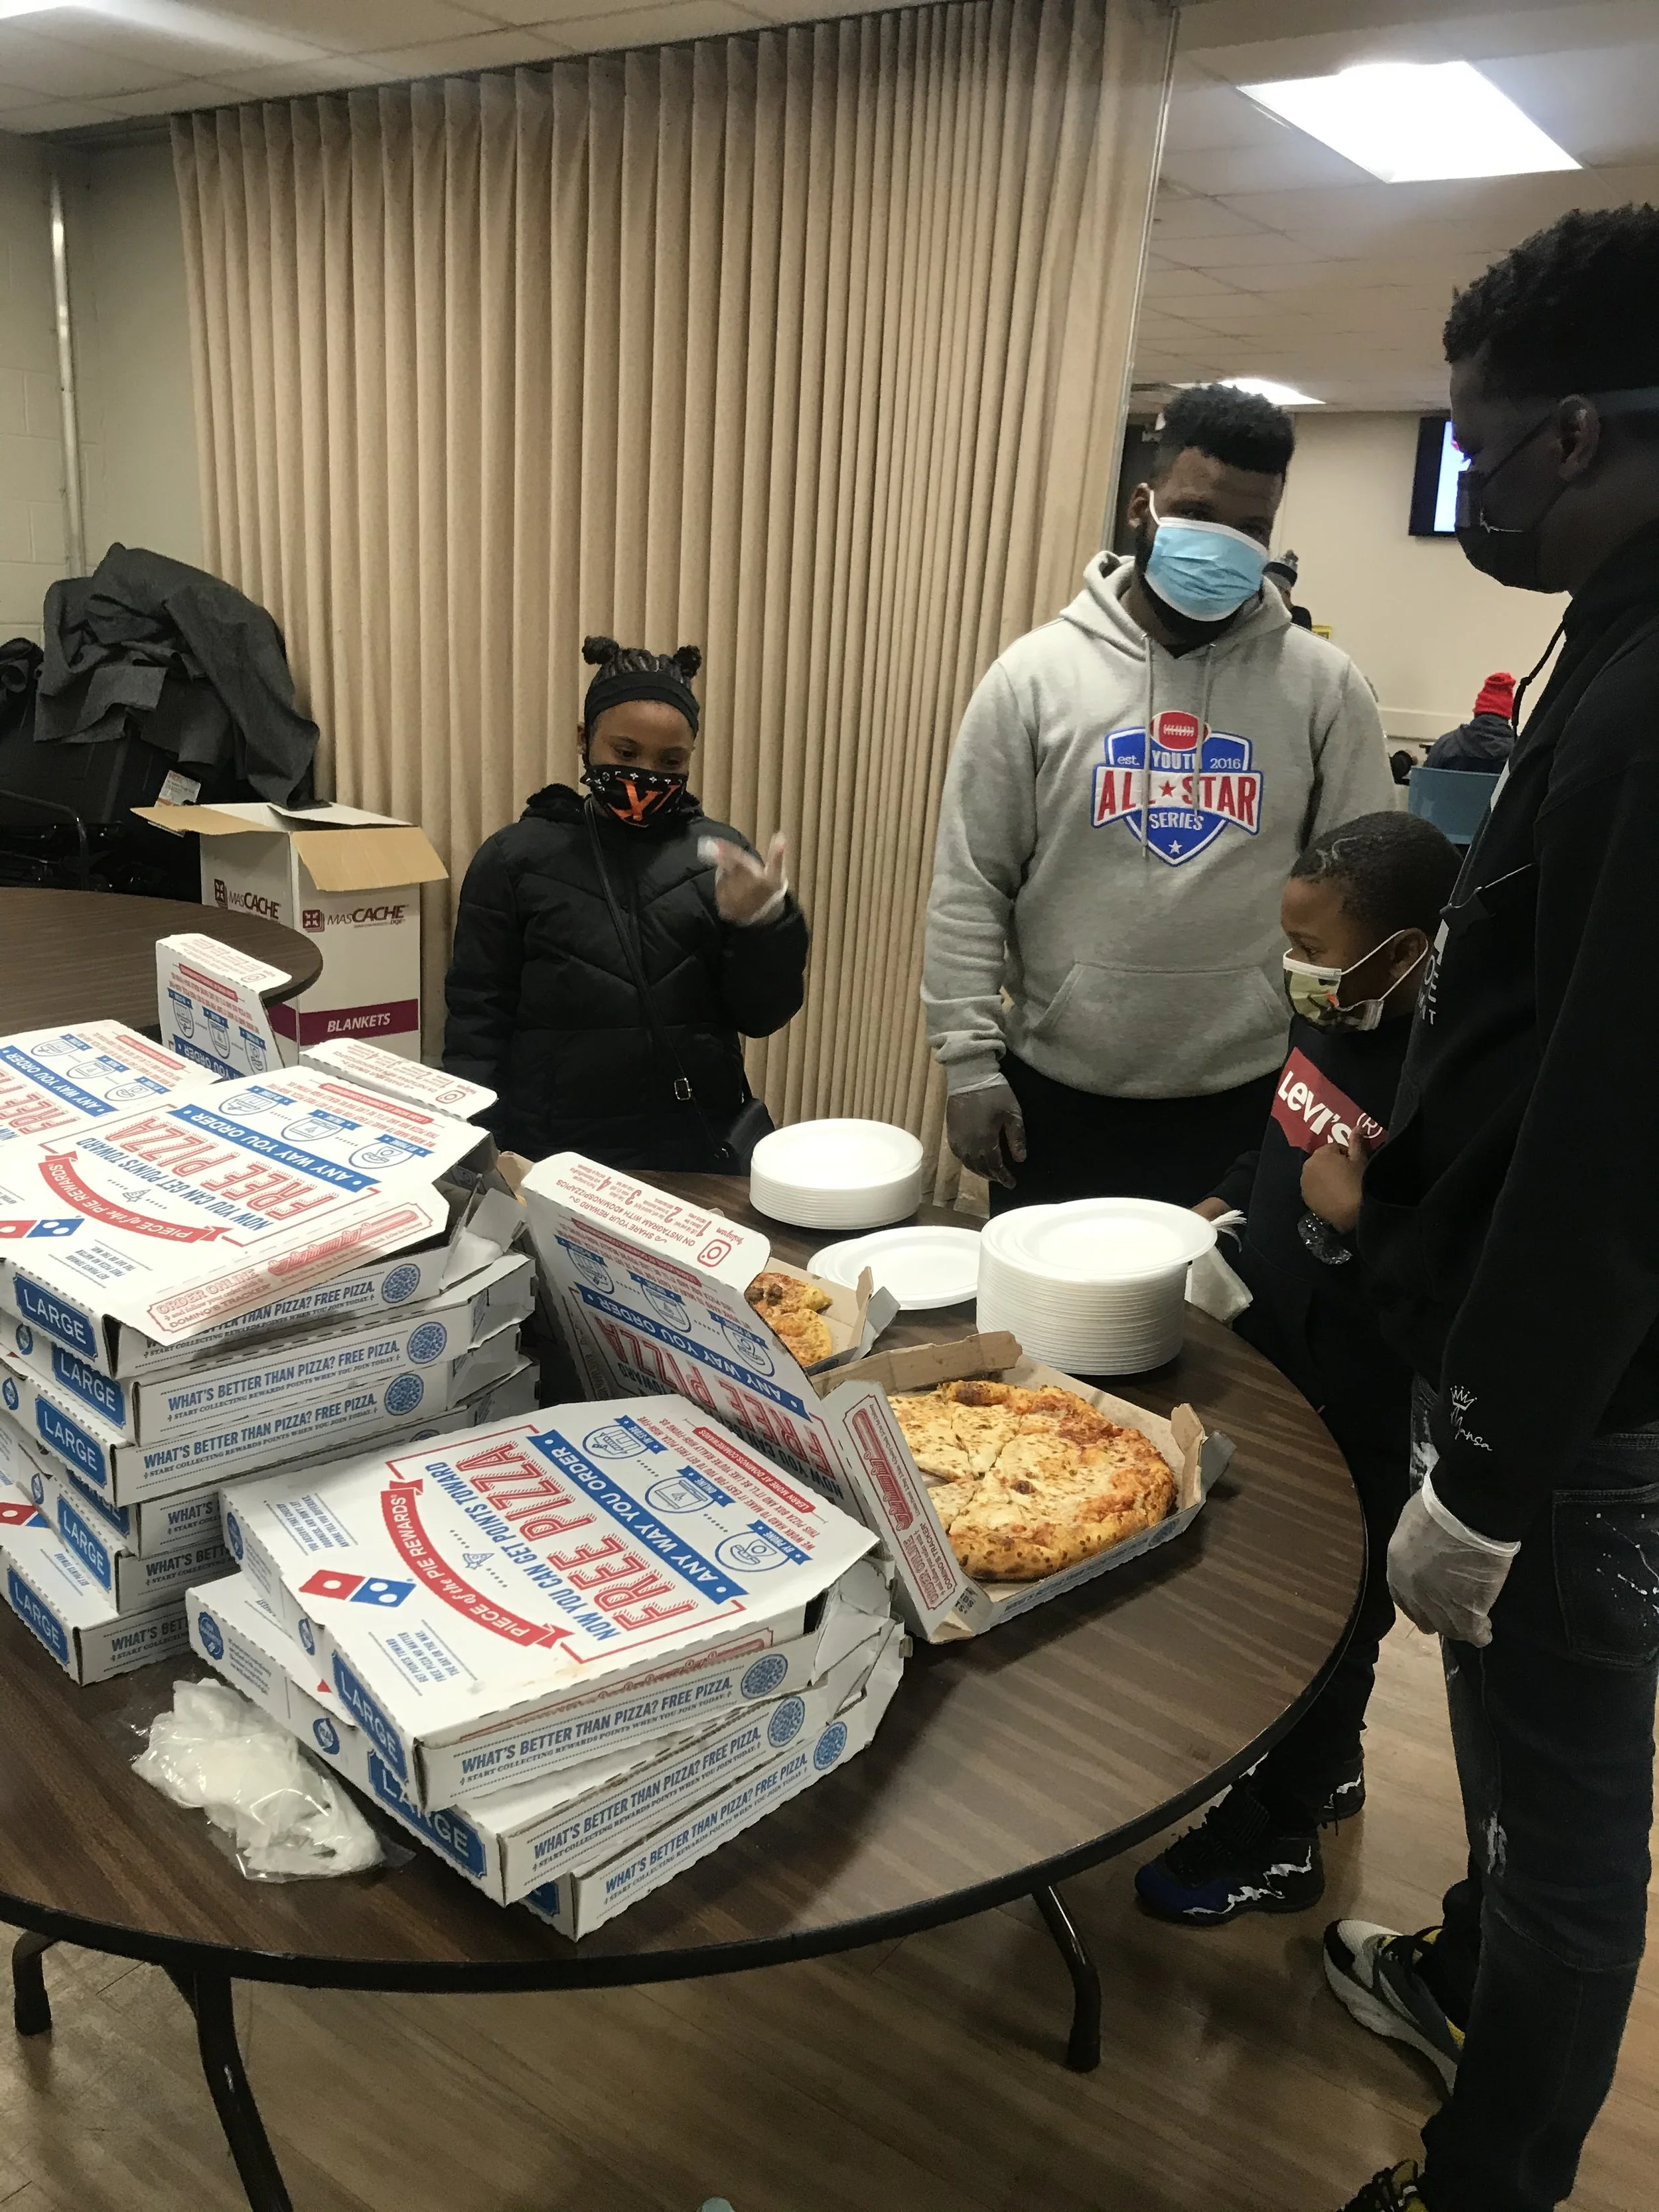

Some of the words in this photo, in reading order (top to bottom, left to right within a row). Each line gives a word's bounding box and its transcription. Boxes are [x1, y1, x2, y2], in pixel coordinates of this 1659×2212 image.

[1118, 755, 1139, 765] est.
[1210, 757, 1241, 769] 2016
[1181, 775, 1257, 827] STAR
[1149, 812, 1204, 831] SERIES
[326, 1013, 392, 1033] BLANKETS
[5, 1052, 42, 1072] ORDER
[184, 1045, 211, 1070] ORDER
[34, 1070, 60, 1084] YOU
[52, 1082, 80, 1096] WAY
[71, 1095, 102, 1109] ANY
[188, 1114, 248, 1136] ORDER
[74, 1137, 132, 1162] TOWARD
[100, 1114, 244, 1178] PIZZA
[240, 1135, 280, 1150] YOU
[273, 1148, 316, 1165] WAY
[117, 1159, 171, 1182] POINTS
[309, 1163, 353, 1182] ANY
[155, 1177, 192, 1193] GET
[198, 1160, 341, 1221] FREE
[596, 1177, 612, 1191] 4
[82, 1199, 106, 1214] PIE
[180, 1189, 218, 1205] CAN
[206, 1201, 243, 1216] YOU
[579, 1201, 610, 1218] REWARD
[625, 1189, 642, 1205] 3
[106, 1210, 128, 1223] the
[126, 1217, 141, 1226] of
[230, 1212, 273, 1230] NOW
[608, 1214, 630, 1228] YOUR
[622, 1210, 643, 1222] WITH
[664, 1207, 683, 1223] 2
[137, 1220, 193, 1238] PIECE
[627, 1223, 654, 1240] SHARE
[640, 1218, 685, 1242] INSTAGRAM
[695, 1220, 713, 1237] 1
[681, 1237, 697, 1247] ON
[156, 1288, 208, 1314] ORDER
[205, 1266, 260, 1296] ONLINE
[274, 1294, 311, 1315] PIZZA?
[314, 1288, 340, 1306] FREE
[342, 1280, 374, 1299] PIZZA.
[23, 1289, 86, 1345] LARGE
[596, 1294, 656, 1335] ORDER
[660, 1327, 699, 1356] YOU
[170, 1387, 213, 1411] WHAT'S
[218, 1375, 261, 1398] BETTER
[265, 1366, 294, 1386] THAN
[298, 1357, 333, 1377] PIZZA?
[338, 1349, 364, 1367] FREE
[368, 1339, 399, 1359] PIZZA.
[702, 1349, 741, 1378] WAY
[60, 1354, 116, 1412] LARGE
[175, 1408, 198, 1419] START
[200, 1395, 246, 1412] COLLECTING
[287, 1378, 312, 1389] POINTS
[315, 1371, 336, 1382] WHEN
[338, 1367, 352, 1376] YOU
[354, 1363, 369, 1371] JOIN
[745, 1372, 782, 1401] ANY
[44, 1411, 98, 1472] LARGE
[145, 1444, 189, 1469] WHAT'S
[194, 1431, 237, 1455] BETTER
[242, 1422, 269, 1441] THAN
[275, 1410, 311, 1432] PIZZA?
[315, 1402, 341, 1421] FREE
[344, 1392, 377, 1412] PIZZA.
[720, 1382, 834, 1480] FREE
[150, 1465, 173, 1477] START
[175, 1450, 224, 1469] COLLECTING
[263, 1432, 289, 1444] POINTS
[291, 1425, 312, 1436] WHEN
[315, 1420, 328, 1430] YOU
[331, 1416, 346, 1425] JOIN
[548, 1448, 611, 1489] ORDER
[419, 1461, 486, 1505] TOWARD
[447, 1438, 603, 1545] PIZZA
[768, 1480, 790, 1496] MORE
[168, 1501, 213, 1525] WHAT'S
[600, 1492, 644, 1518] YOU
[786, 1493, 810, 1510] LEARN
[461, 1504, 520, 1542] POINTS
[632, 1520, 681, 1549] WAY
[64, 1509, 105, 1576] LARGE
[500, 1541, 541, 1564] GET
[146, 1554, 192, 1577] WHAT'S
[416, 1557, 445, 1580] PIE
[522, 1562, 567, 1589] CAN
[670, 1552, 720, 1583] ANY
[440, 1578, 463, 1594] the
[543, 1529, 701, 1633] FREE
[452, 1593, 477, 1604] of
[549, 1587, 591, 1613] YOU
[15, 1582, 60, 1650] LARGE
[469, 1603, 531, 1638] PIECE
[573, 1609, 621, 1641] NOW
[111, 1626, 157, 1652] WHAT'S
[340, 1670, 398, 1763] LARGE
[463, 1744, 514, 1773] WHAT'S
[520, 1727, 571, 1755] BETTER
[577, 1714, 610, 1737] THAN
[614, 1700, 656, 1726] PIZZA?
[661, 1689, 691, 1710] FREE
[695, 1676, 733, 1700] PIZZA.
[467, 1768, 494, 1783] START
[497, 1749, 552, 1773] COLLECTING
[599, 1724, 630, 1739] POINTS
[632, 1715, 656, 1728] WHEN
[660, 1709, 676, 1720] YOU
[679, 1702, 696, 1713] JOIN
[535, 1822, 579, 1859] WHAT'S
[584, 1796, 627, 1833] BETTER
[632, 1779, 659, 1807] THAN
[663, 1757, 699, 1790] PIZZA?
[702, 1743, 727, 1769] FREE
[730, 1725, 760, 1754] PIZZA.
[607, 1857, 645, 1893] WHAT'S
[650, 1828, 688, 1866] BETTER
[691, 1810, 717, 1838] THAN
[720, 1787, 752, 1820] PIZZA?
[755, 1771, 777, 1797] FREE
[780, 1751, 808, 1780] PIZZA.
